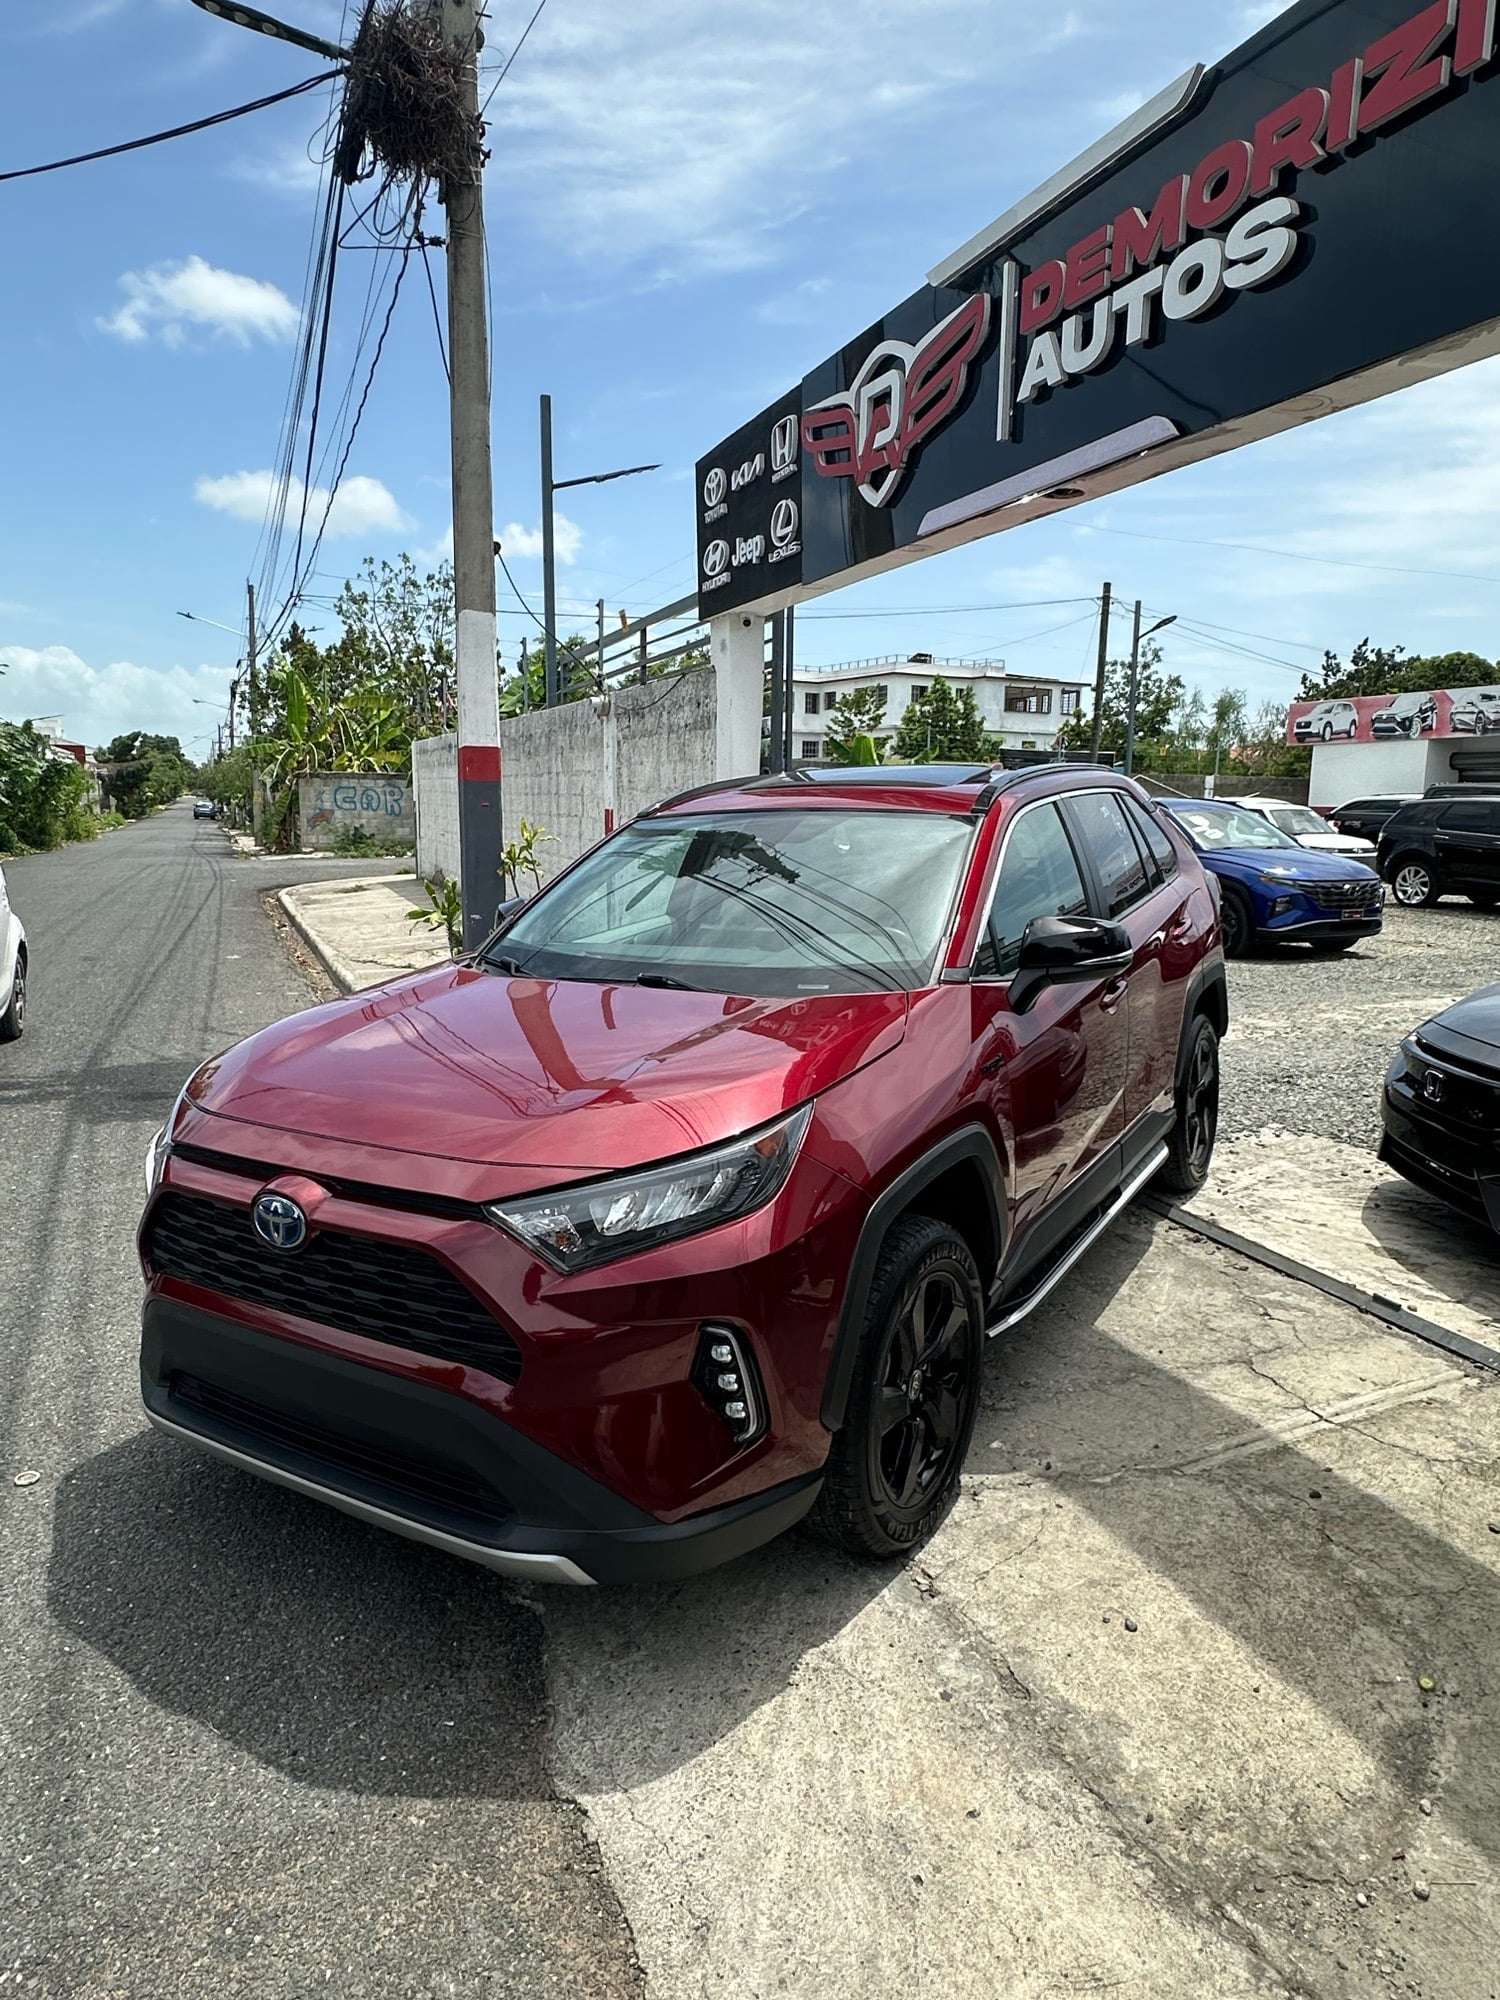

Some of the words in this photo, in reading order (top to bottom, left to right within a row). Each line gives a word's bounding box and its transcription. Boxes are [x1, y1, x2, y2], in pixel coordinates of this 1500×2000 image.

[1016, 197, 1299, 402] AUTOS
[772, 463, 797, 483] HONDA
[704, 503, 727, 523] TOYOTA
[732, 535, 764, 566] Jeep
[769, 541, 800, 562] LEXUS
[702, 572, 731, 592] HYUNDAI
